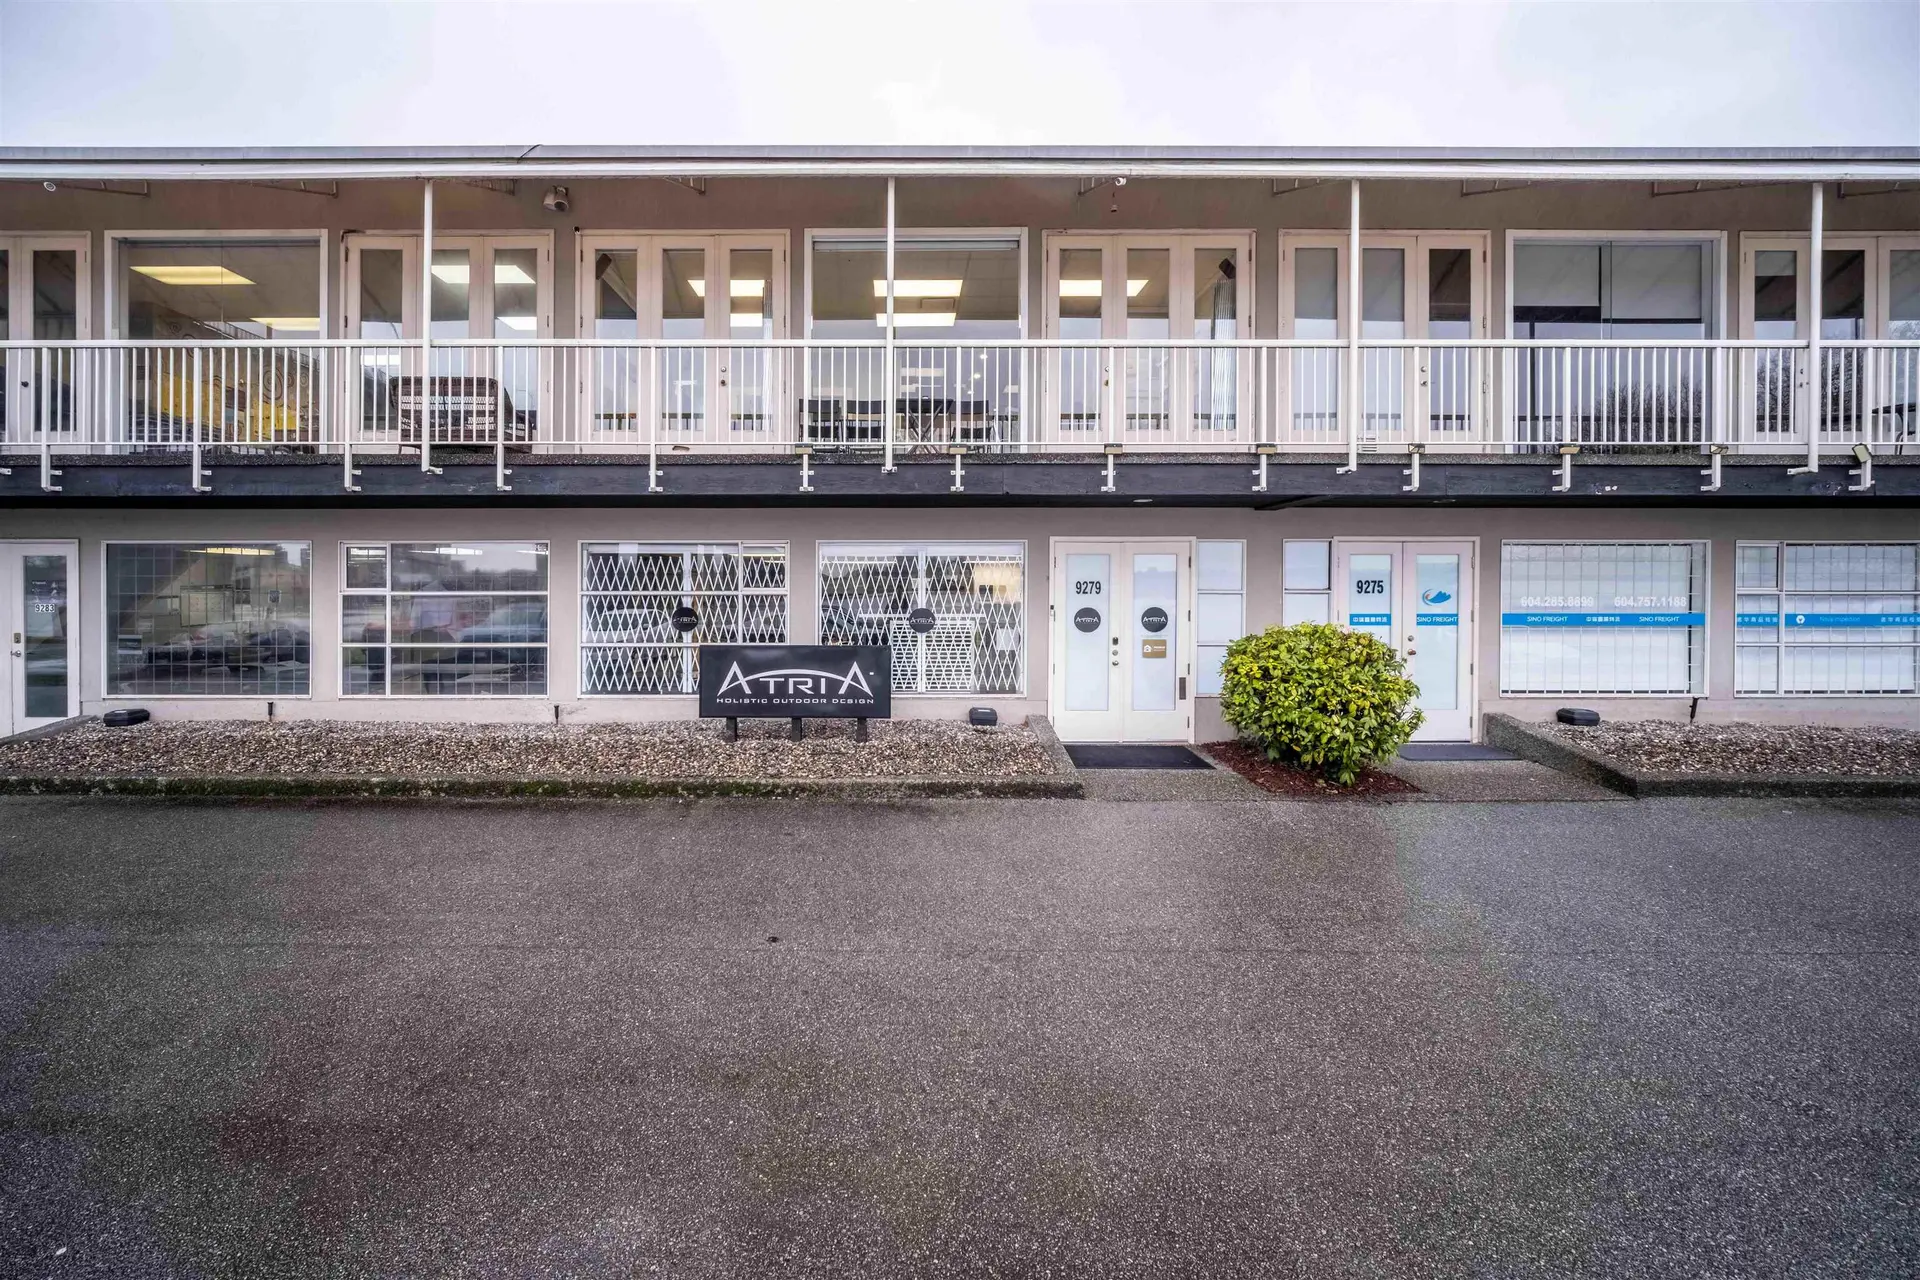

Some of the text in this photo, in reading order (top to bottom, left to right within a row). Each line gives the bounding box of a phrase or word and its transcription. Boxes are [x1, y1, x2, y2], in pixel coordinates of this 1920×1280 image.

[1076, 581, 1101, 594] 9279
[1356, 580, 1384, 594] 9275
[35, 604, 55, 612] 9283
[1614, 597, 1687, 607] 604.757.1188
[717, 661, 874, 697] ATRIA
